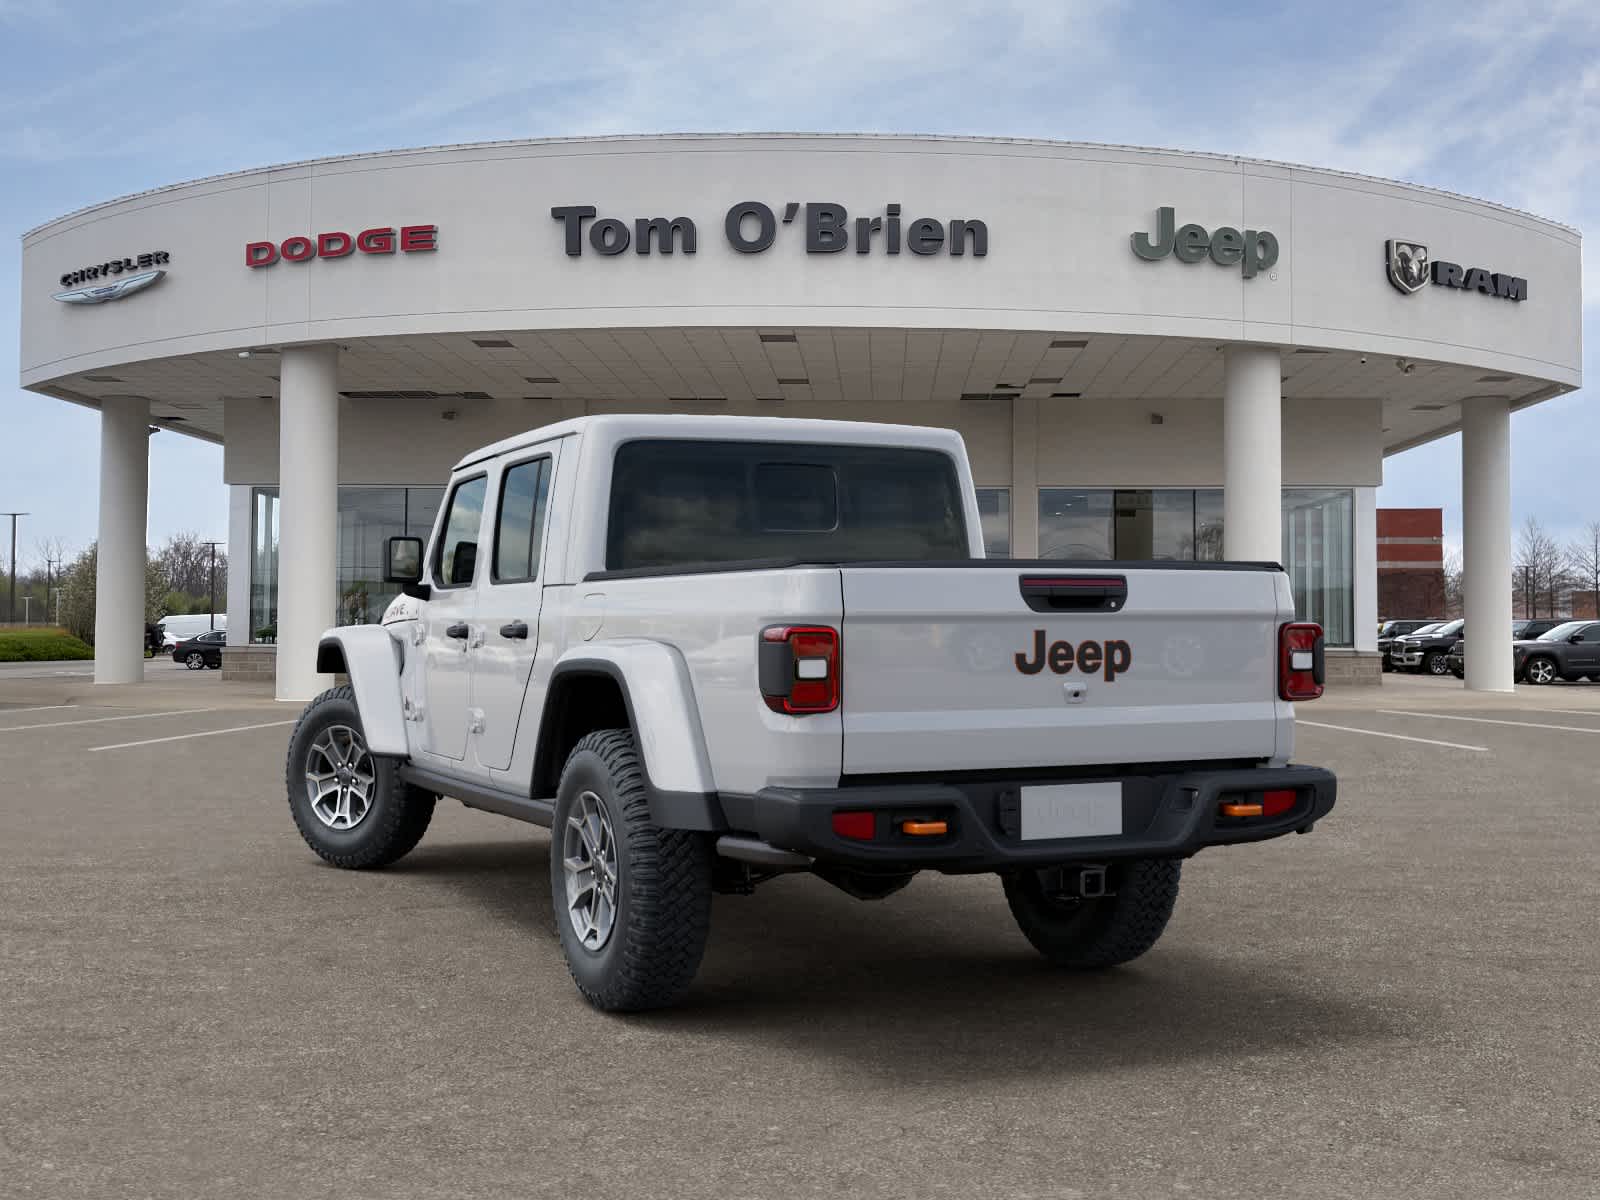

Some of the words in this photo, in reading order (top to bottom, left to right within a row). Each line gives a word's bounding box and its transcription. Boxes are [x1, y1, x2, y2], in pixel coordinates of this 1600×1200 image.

[245, 224, 438, 269] DODGE
[551, 204, 697, 256] Tom
[725, 201, 989, 257] O'Brien
[1130, 206, 1280, 280] Jeep
[60, 250, 170, 287] CHRYSLER
[1430, 260, 1528, 302] RAM
[1014, 629, 1132, 682] Jeep
